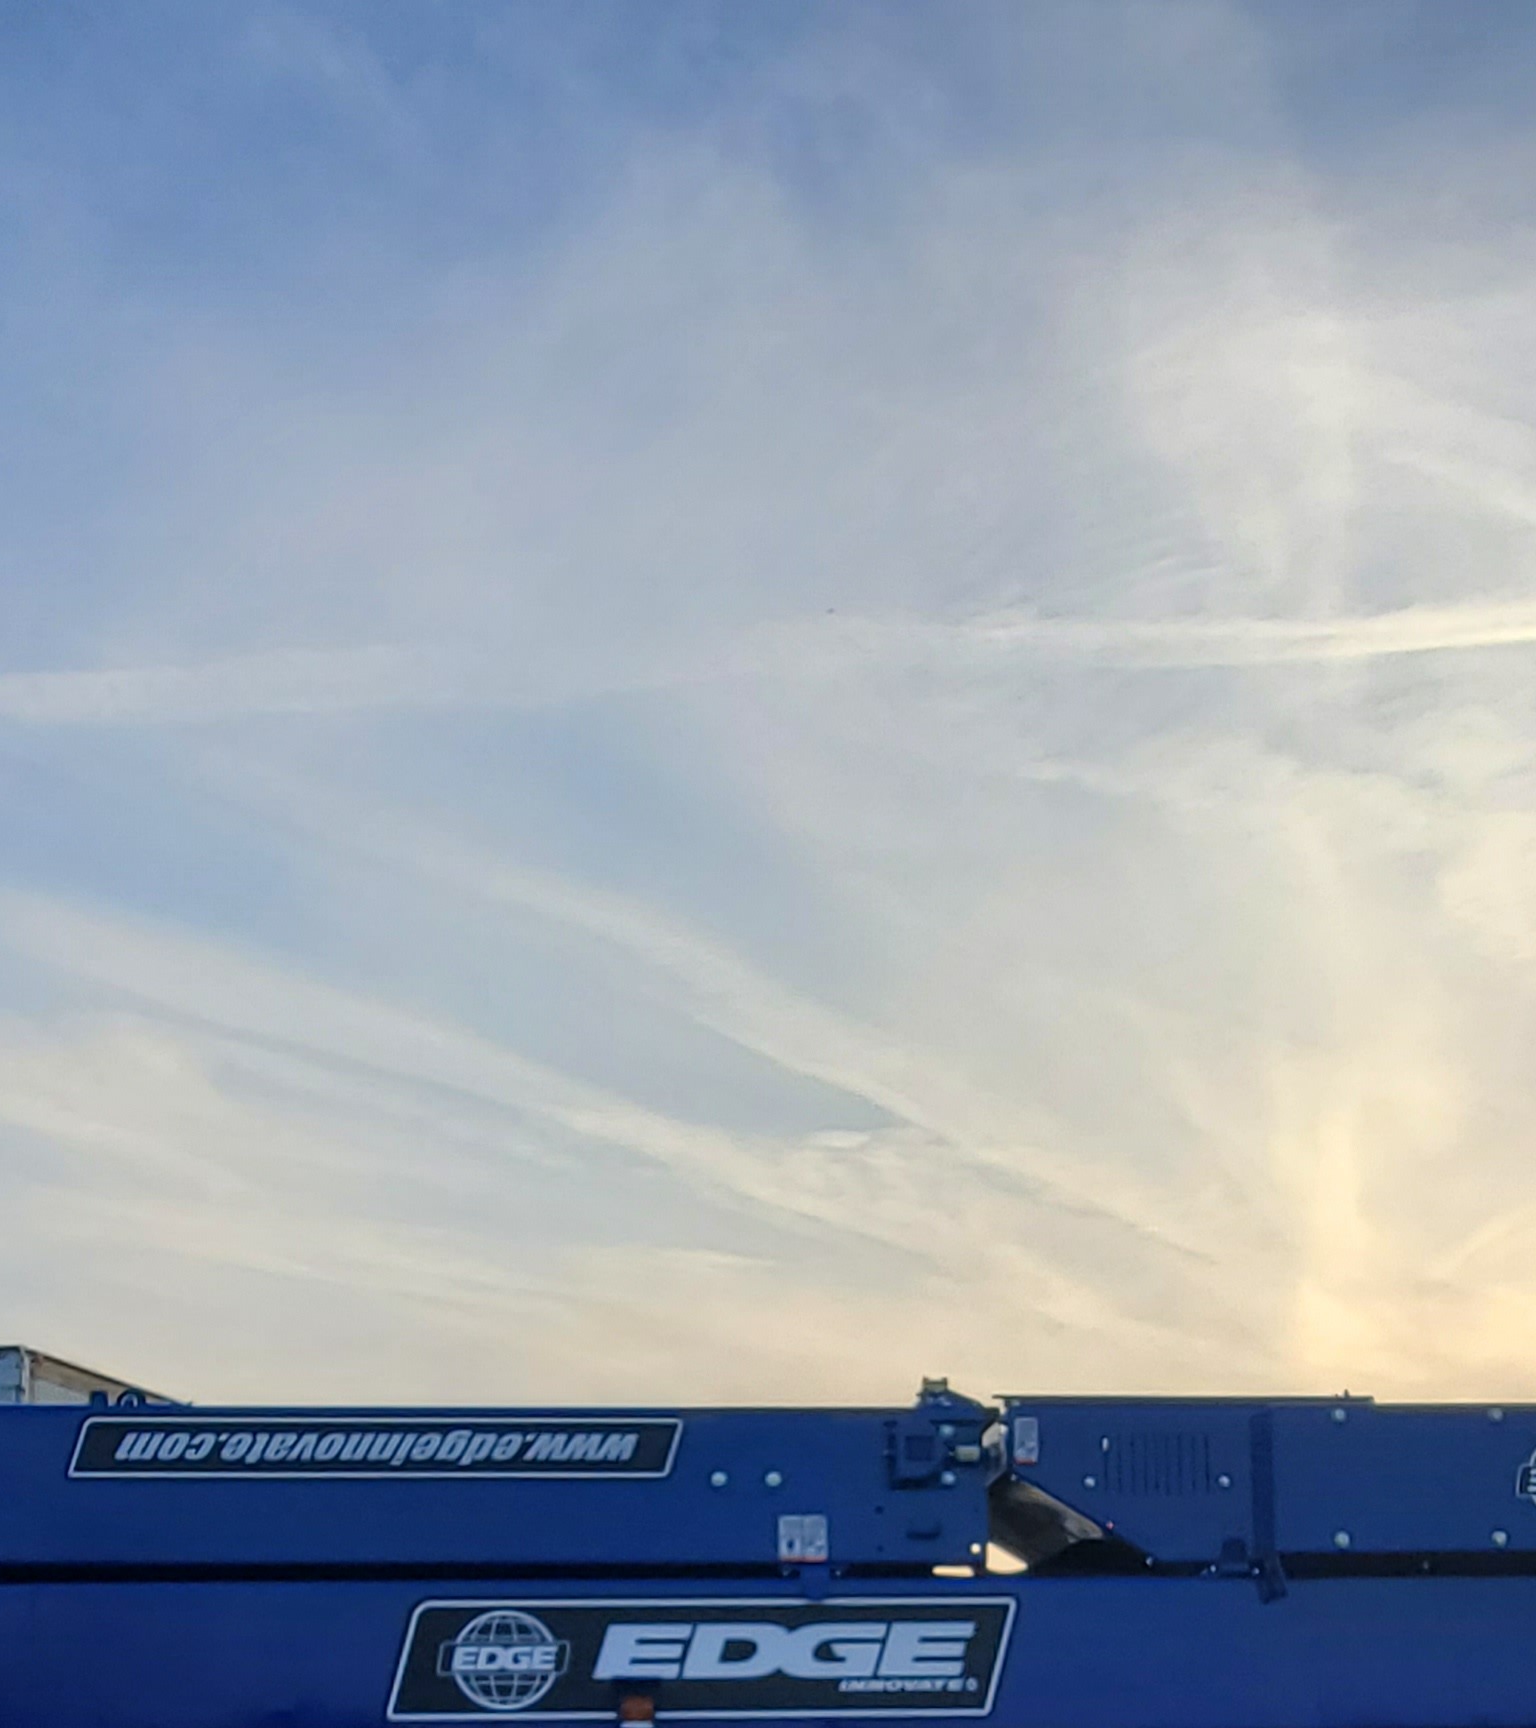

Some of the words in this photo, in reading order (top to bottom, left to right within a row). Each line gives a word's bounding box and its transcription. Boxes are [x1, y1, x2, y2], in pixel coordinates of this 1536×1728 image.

[114, 1431, 639, 1467] www.edgeinnovate.com
[451, 1645, 557, 1670] EDGE
[592, 1621, 977, 1680] EDGE
